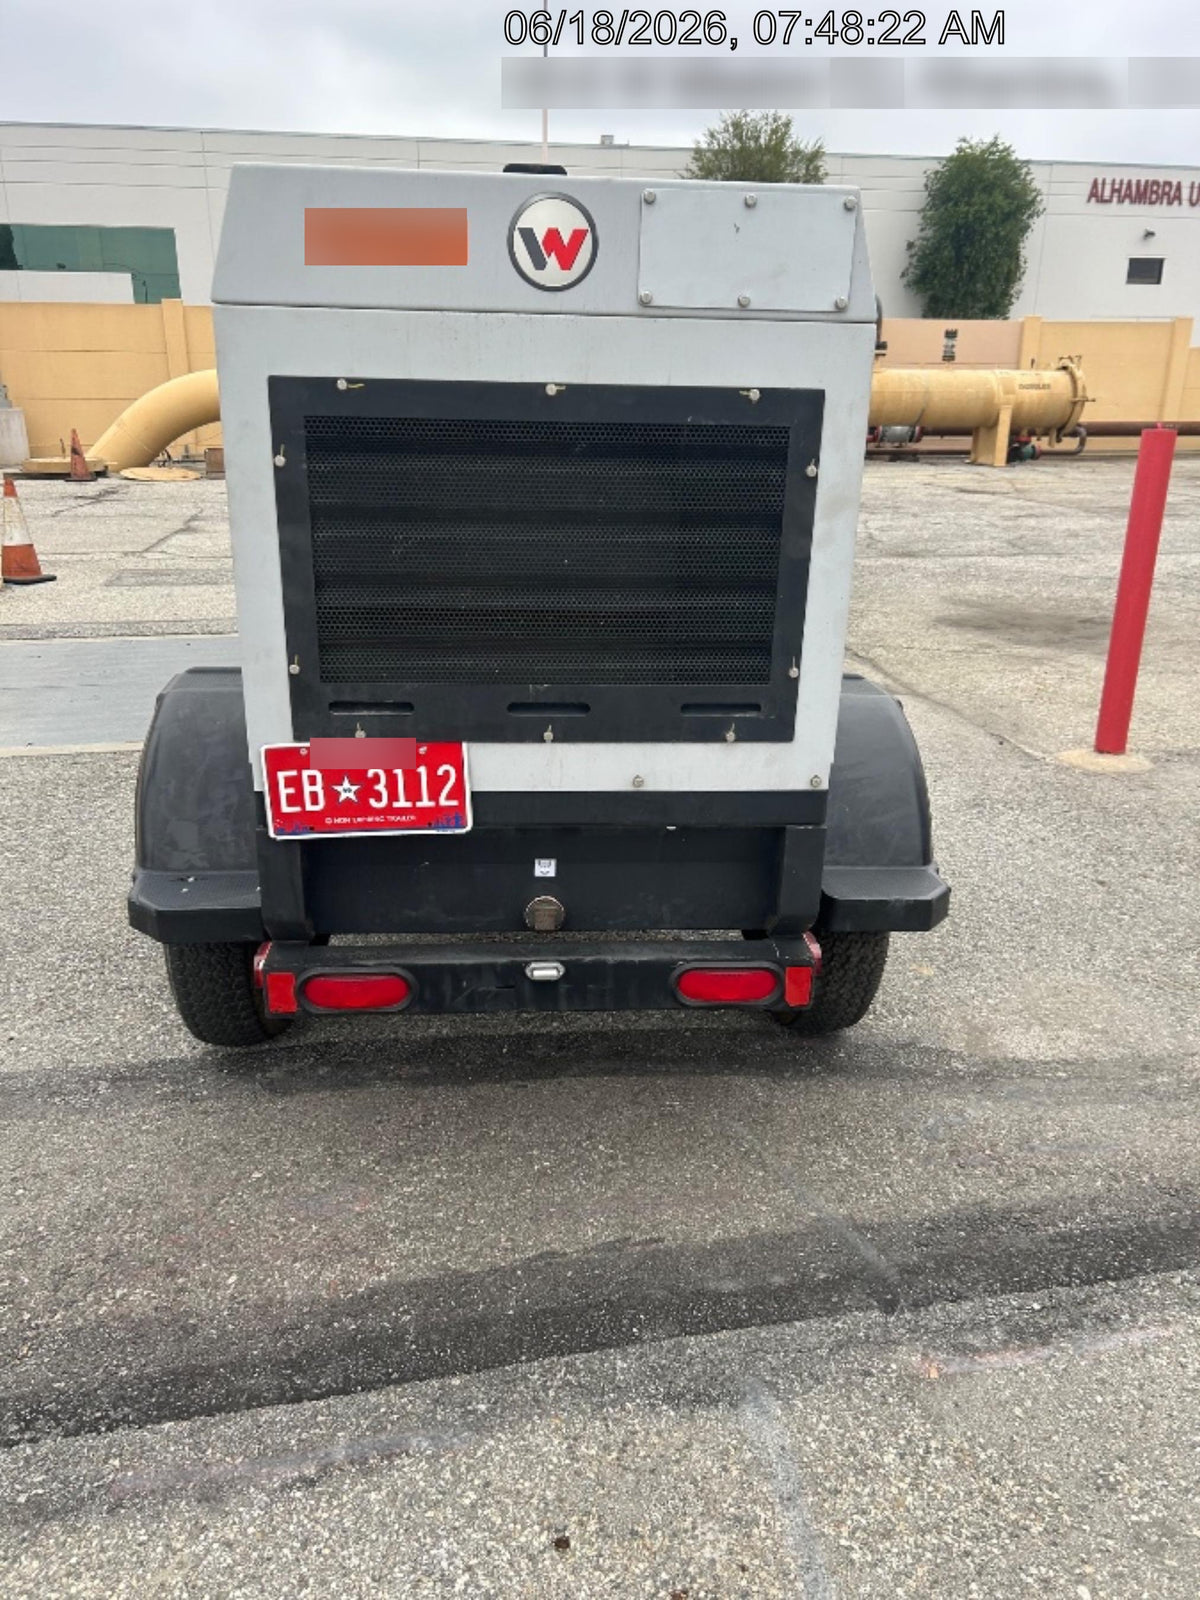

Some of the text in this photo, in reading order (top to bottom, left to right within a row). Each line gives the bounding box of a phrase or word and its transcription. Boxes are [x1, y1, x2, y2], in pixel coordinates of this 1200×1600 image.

[1087, 177, 1200, 206] ALHAMBRA U
[276, 764, 459, 813] EB 3112
